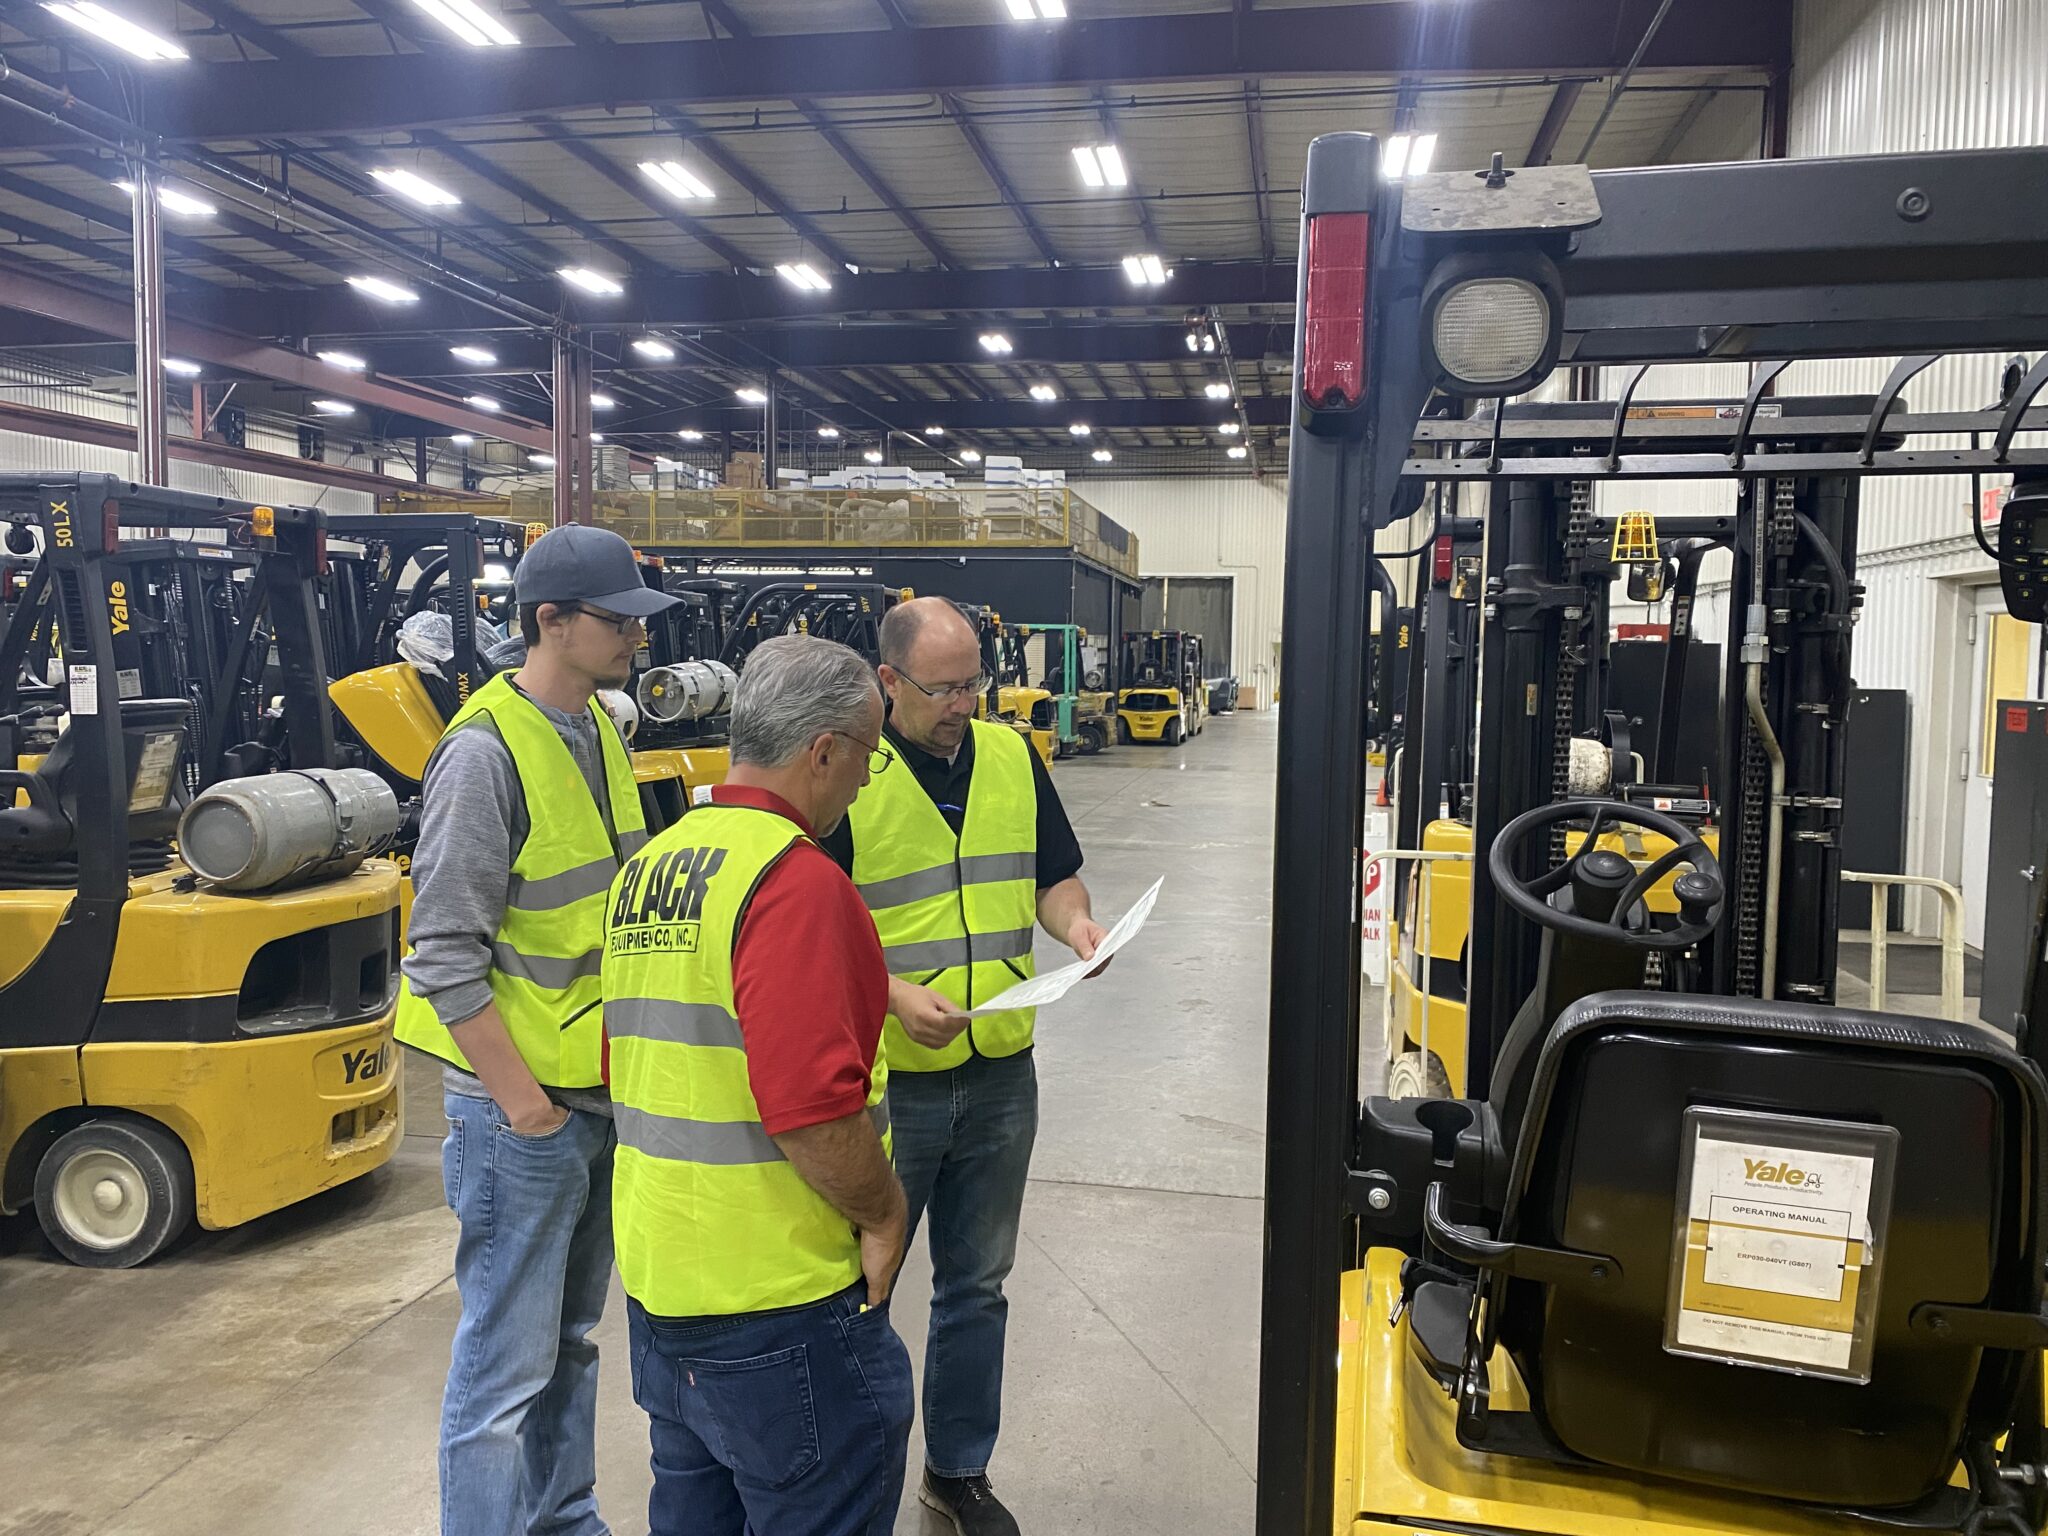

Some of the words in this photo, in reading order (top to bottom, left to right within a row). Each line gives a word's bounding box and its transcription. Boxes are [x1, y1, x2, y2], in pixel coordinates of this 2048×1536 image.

[50, 500, 74, 548] 50LX
[108, 580, 130, 636] Yale
[1398, 624, 1409, 649] Yale
[611, 846, 729, 929] BLACK
[1363, 927, 1380, 940] ALK
[342, 1041, 390, 1085] Yale
[1743, 1158, 1806, 1186] Yale
[1732, 1205, 1786, 1219] OPERATING
[1788, 1213, 1828, 1224] MANUAL
[1737, 1252, 1788, 1265] ERP030-040VT
[1724, 1321, 1748, 1330] REMOVE
[1762, 1328, 1786, 1336] MANUAL
